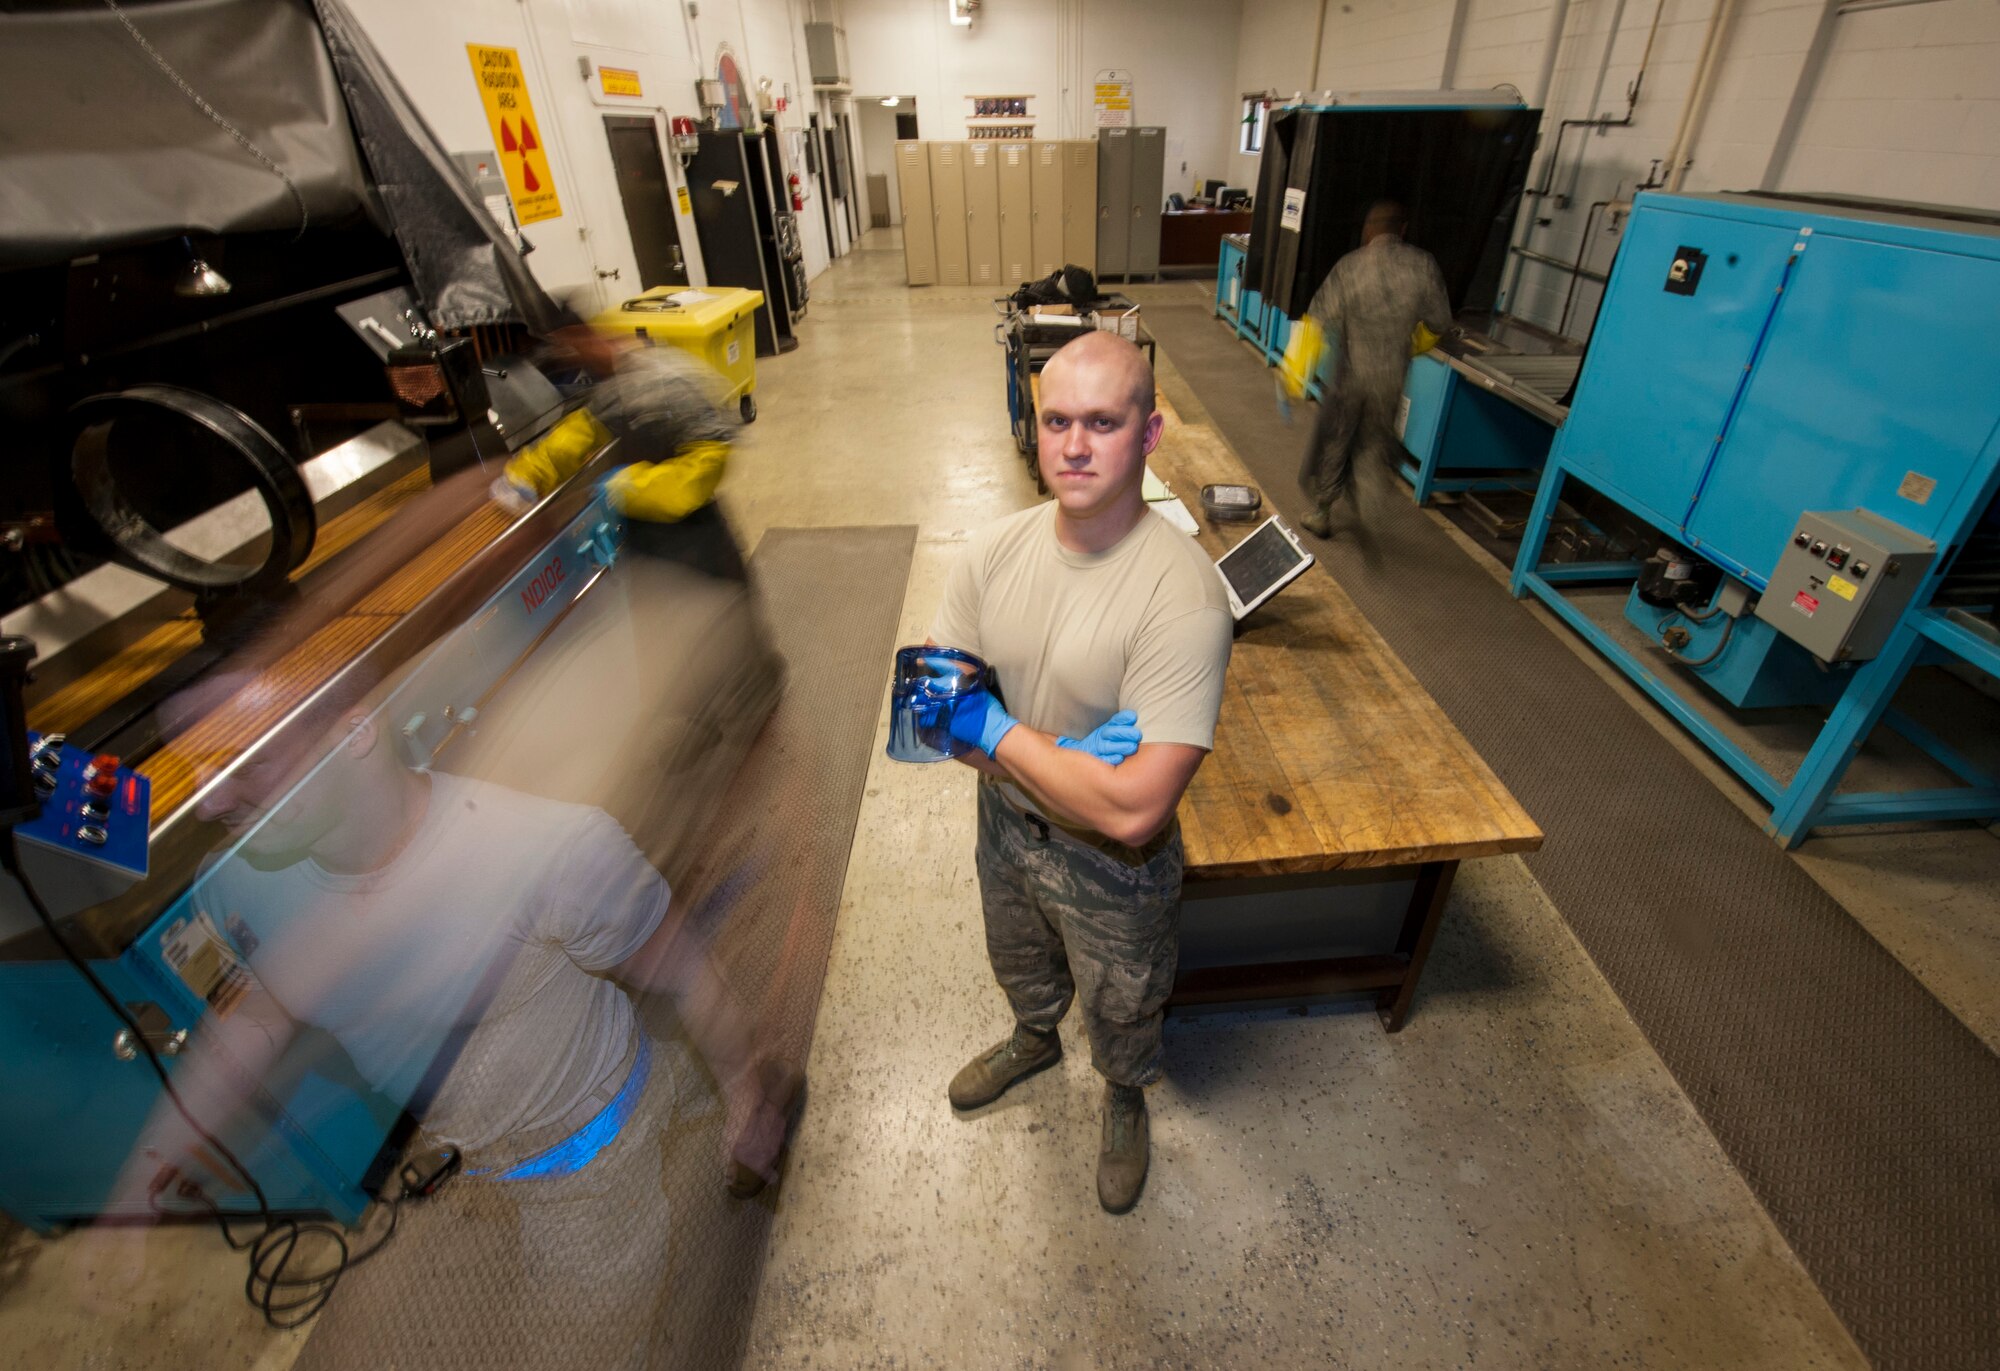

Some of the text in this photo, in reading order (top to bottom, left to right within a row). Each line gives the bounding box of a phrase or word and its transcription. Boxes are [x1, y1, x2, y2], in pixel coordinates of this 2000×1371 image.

[478, 49, 512, 68] CAUTION
[481, 70, 520, 88] RADIATION
[498, 92, 517, 109] AREA
